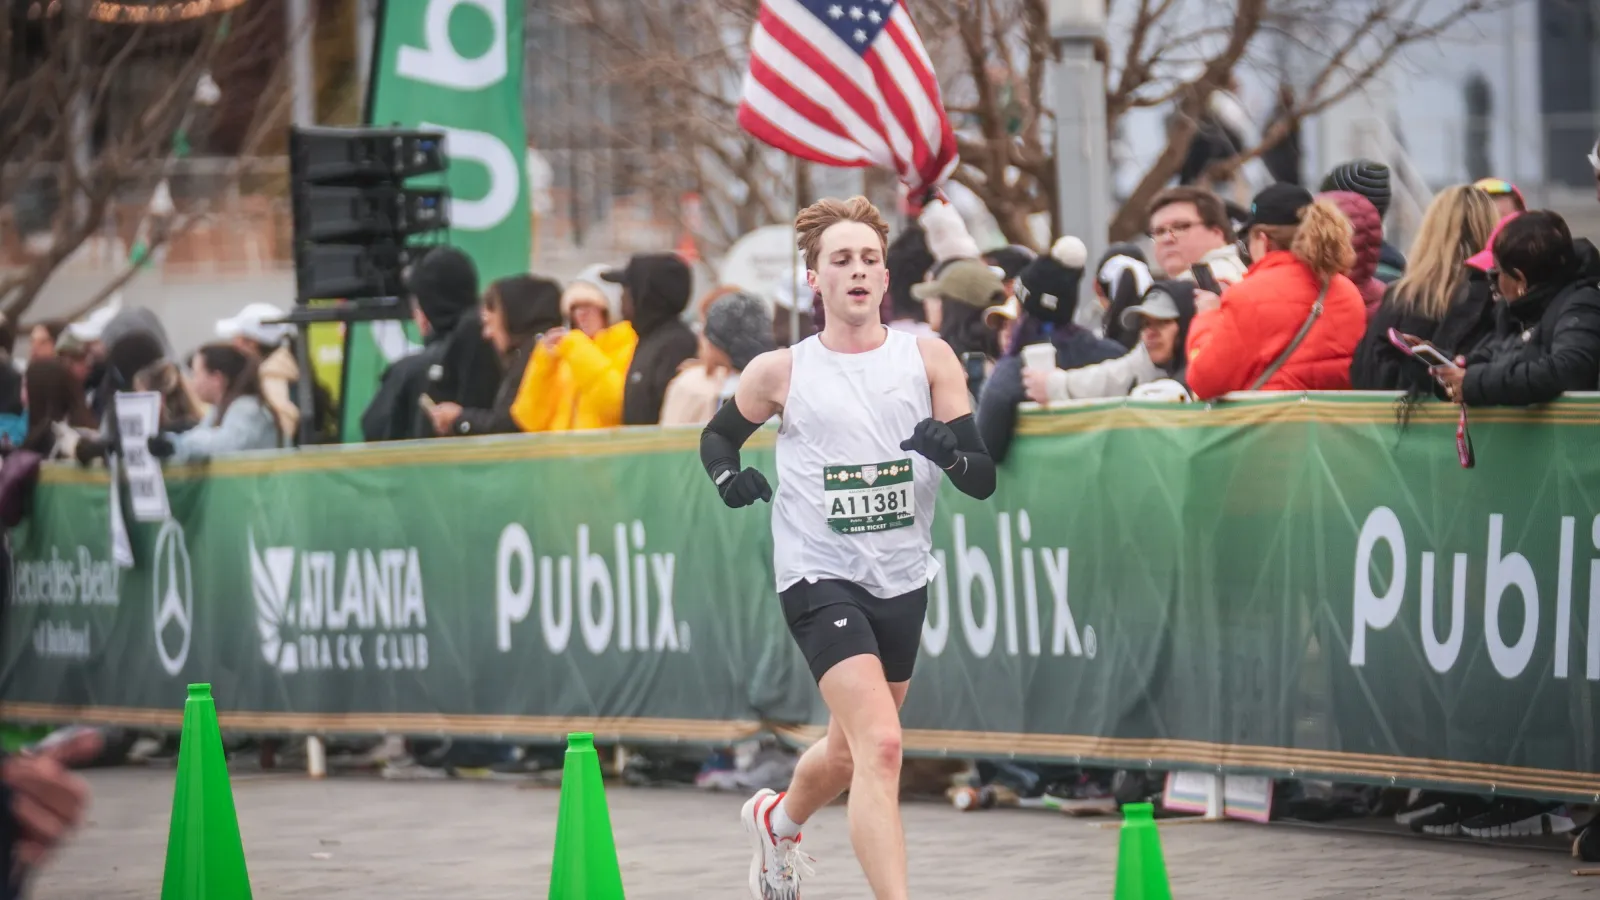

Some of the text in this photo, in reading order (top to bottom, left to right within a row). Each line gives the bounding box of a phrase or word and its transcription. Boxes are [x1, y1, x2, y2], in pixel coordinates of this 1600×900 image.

[831, 489, 907, 516] A11381
[867, 523, 887, 531] TICKET
[299, 546, 427, 631] ATLANTA
[496, 518, 679, 654] Publix
[922, 508, 1082, 658] ublix
[299, 632, 429, 670] TRACK CLUB
